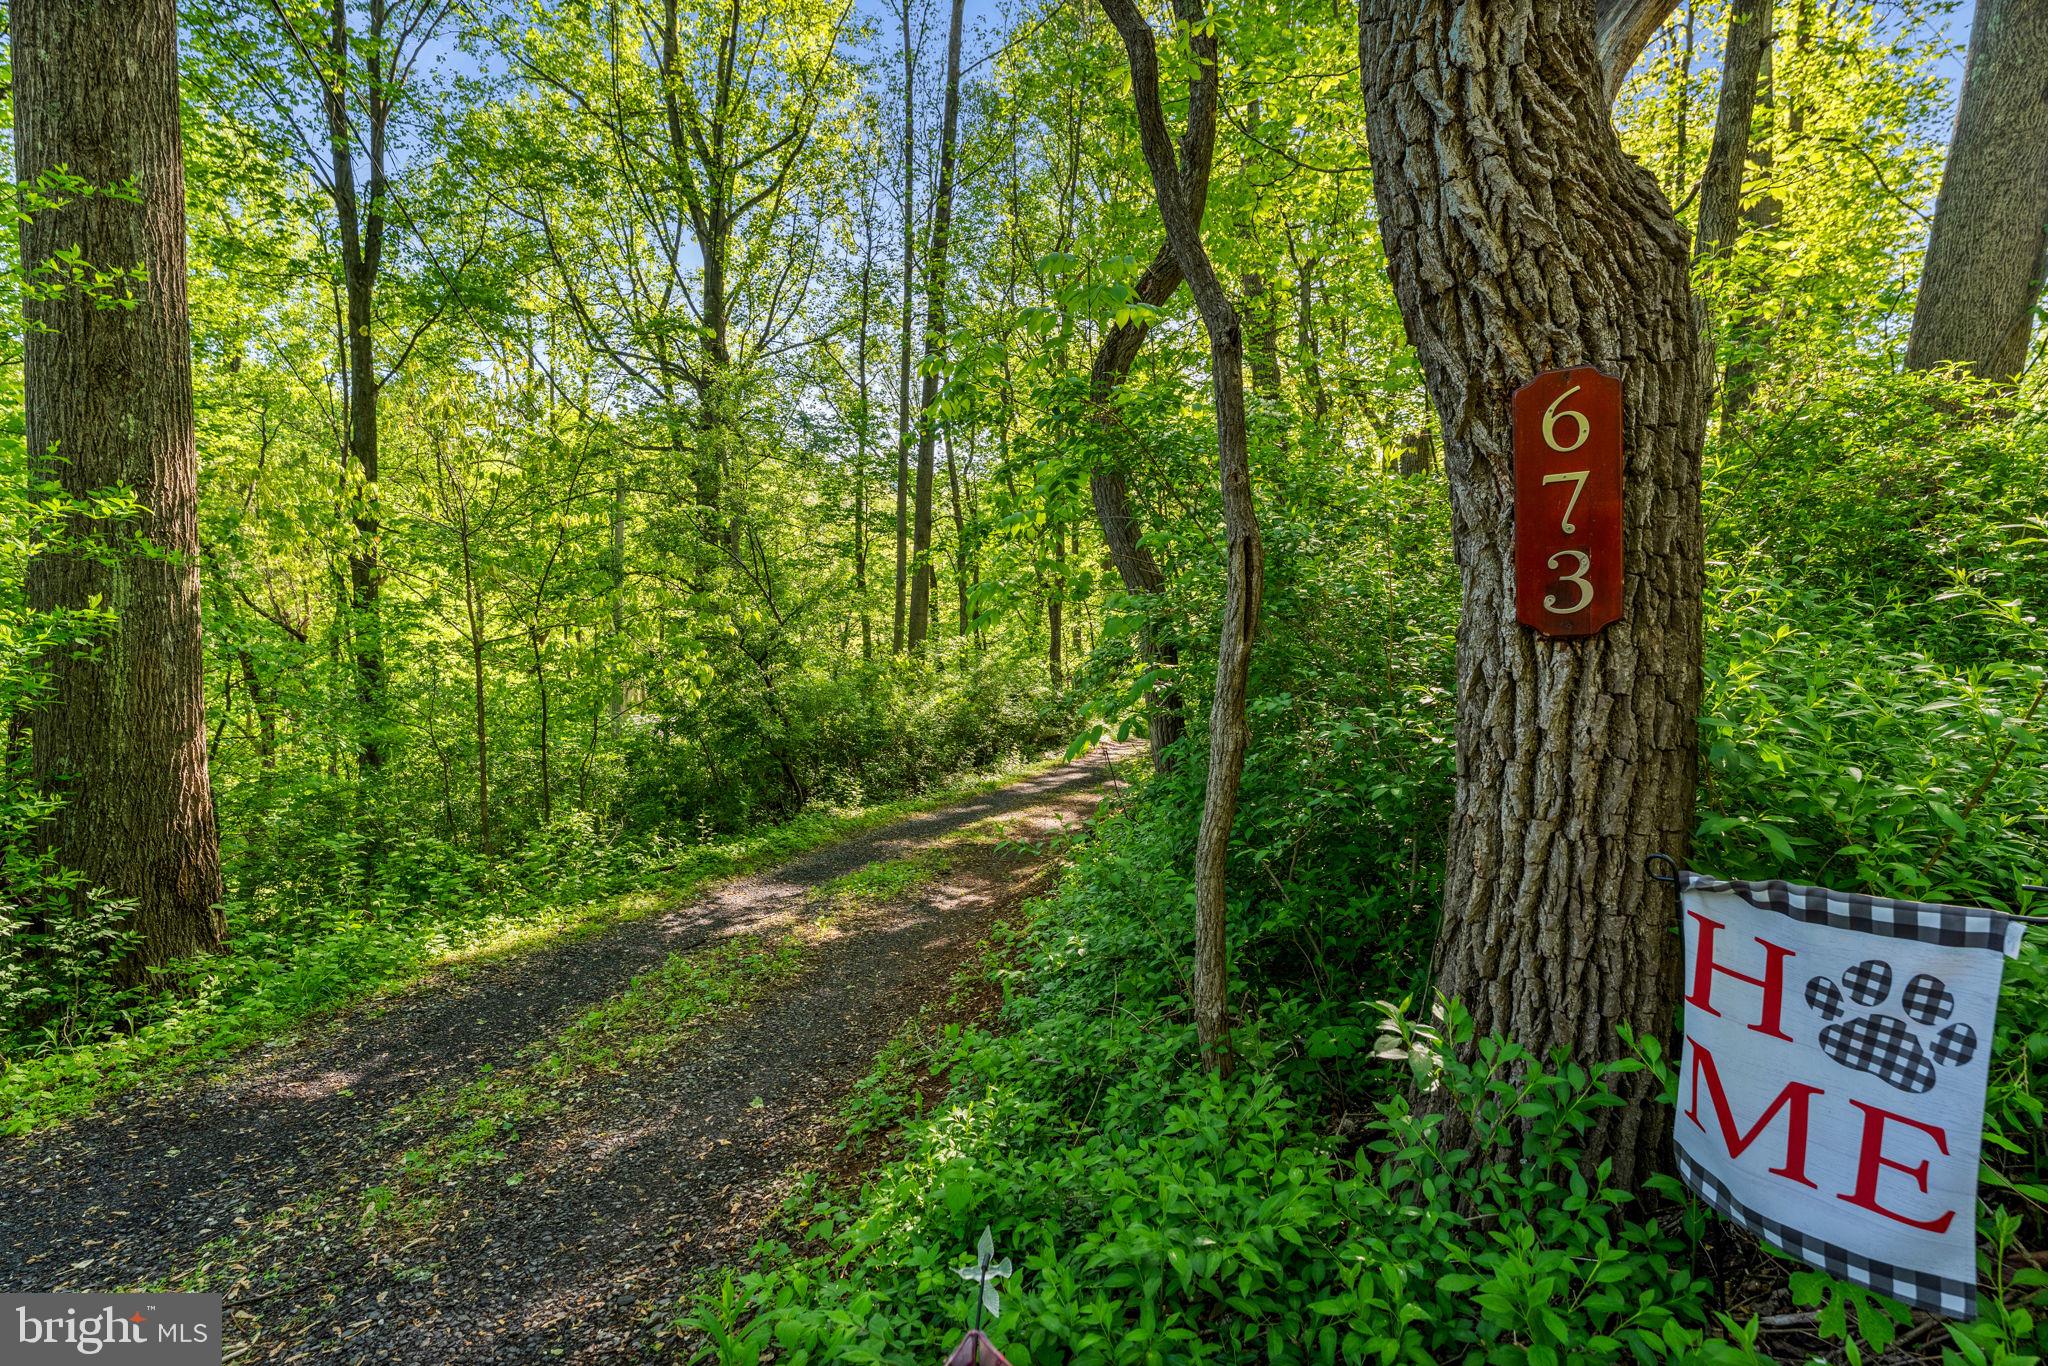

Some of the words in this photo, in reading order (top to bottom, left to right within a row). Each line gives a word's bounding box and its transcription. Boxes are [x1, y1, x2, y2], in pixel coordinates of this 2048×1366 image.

[1542, 385, 1594, 614] 673
[1685, 910, 1796, 1042] H
[1684, 1034, 1955, 1234] ME
